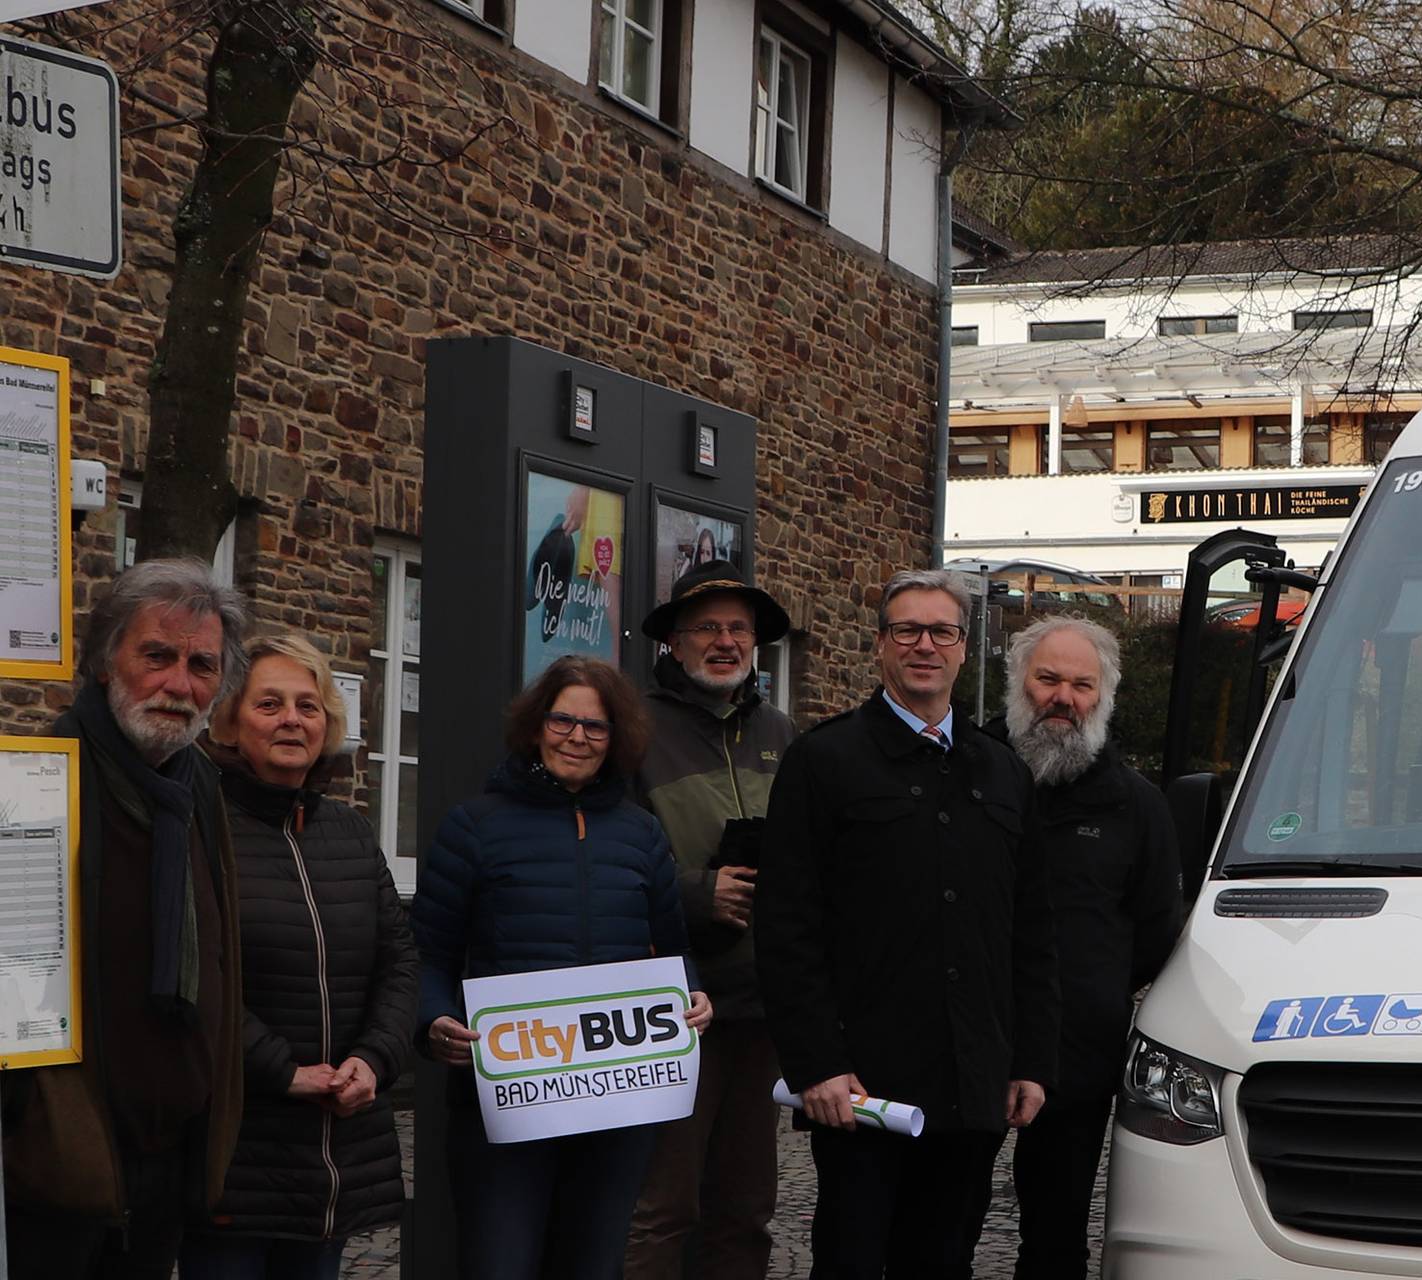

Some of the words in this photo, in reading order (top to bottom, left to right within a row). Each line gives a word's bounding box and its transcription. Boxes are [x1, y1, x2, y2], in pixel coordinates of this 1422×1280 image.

[0, 76, 77, 139] bus
[85, 477, 103, 494] WC
[1291, 498, 1349, 506] THAILÄNDISCHE
[1305, 490, 1327, 498] FEINE
[1175, 493, 1225, 518] KHON
[1236, 491, 1282, 516] THAI
[1290, 506, 1316, 514] KÜCHE
[535, 561, 565, 604] Die
[543, 598, 569, 639] ich
[487, 1003, 680, 1064] CityBUS
[495, 1081, 540, 1107] BAD
[543, 1060, 688, 1100] MÜNSTEREIFEL
